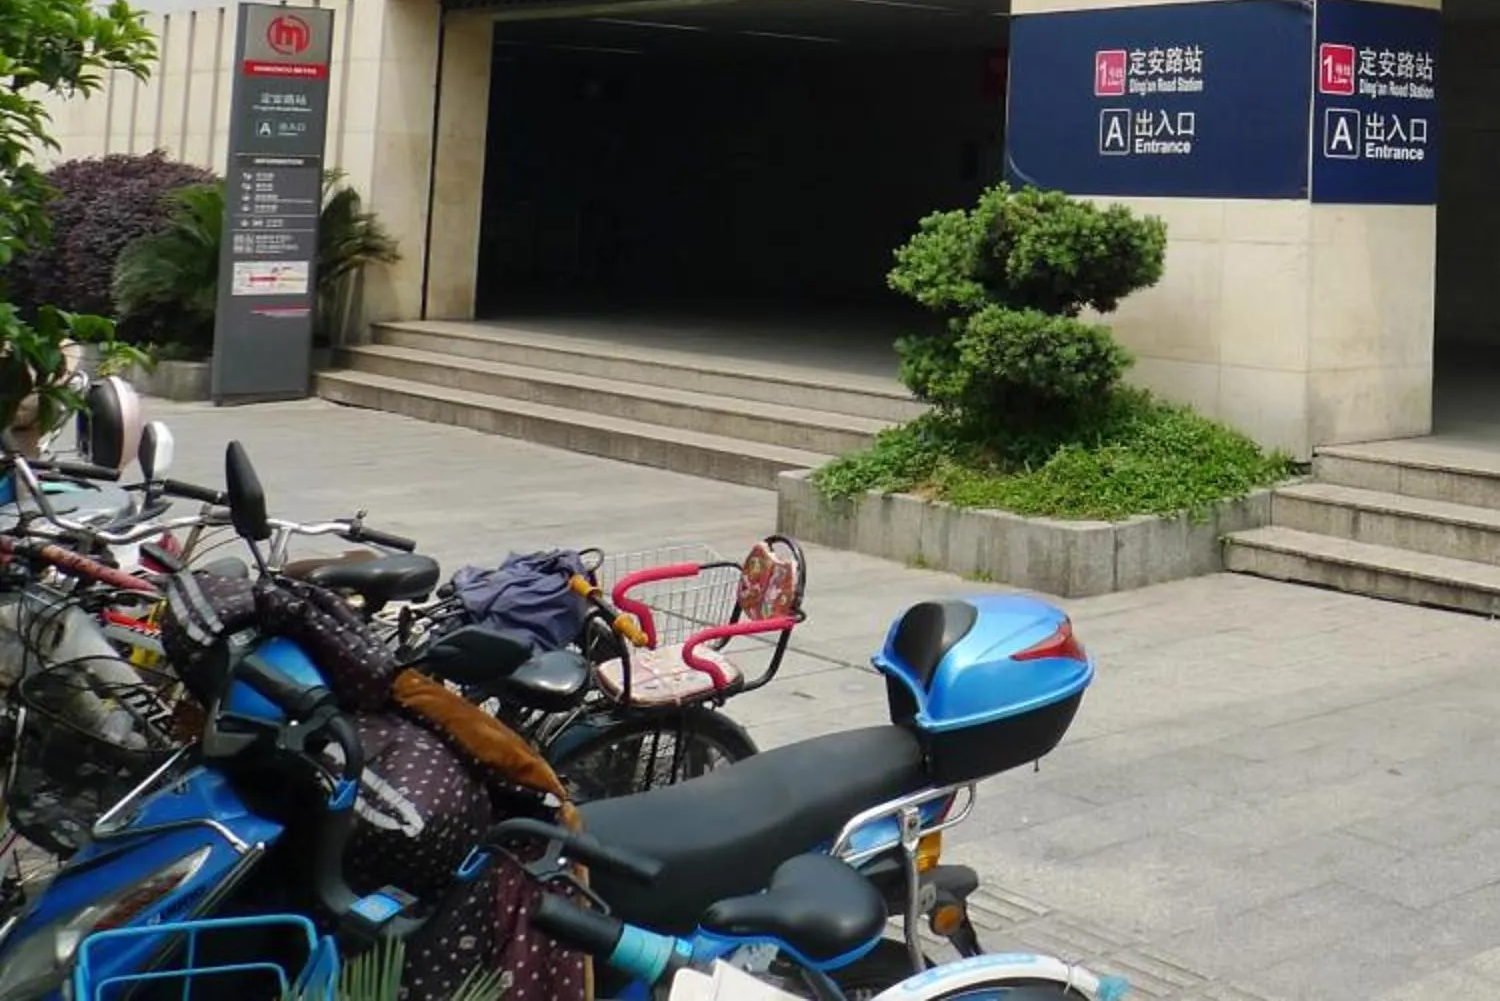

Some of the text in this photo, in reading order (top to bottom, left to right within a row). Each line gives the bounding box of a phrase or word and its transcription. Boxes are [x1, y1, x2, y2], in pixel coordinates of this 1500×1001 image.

[1128, 45, 1204, 75] 定安路站
[1358, 46, 1433, 81] 定安路站
[1410, 82, 1434, 99] Station
[1105, 109, 1195, 148] A 出入口
[1331, 112, 1427, 151] A 出入口
[1135, 139, 1191, 154] Entrance
[1365, 142, 1425, 160] Entrance
